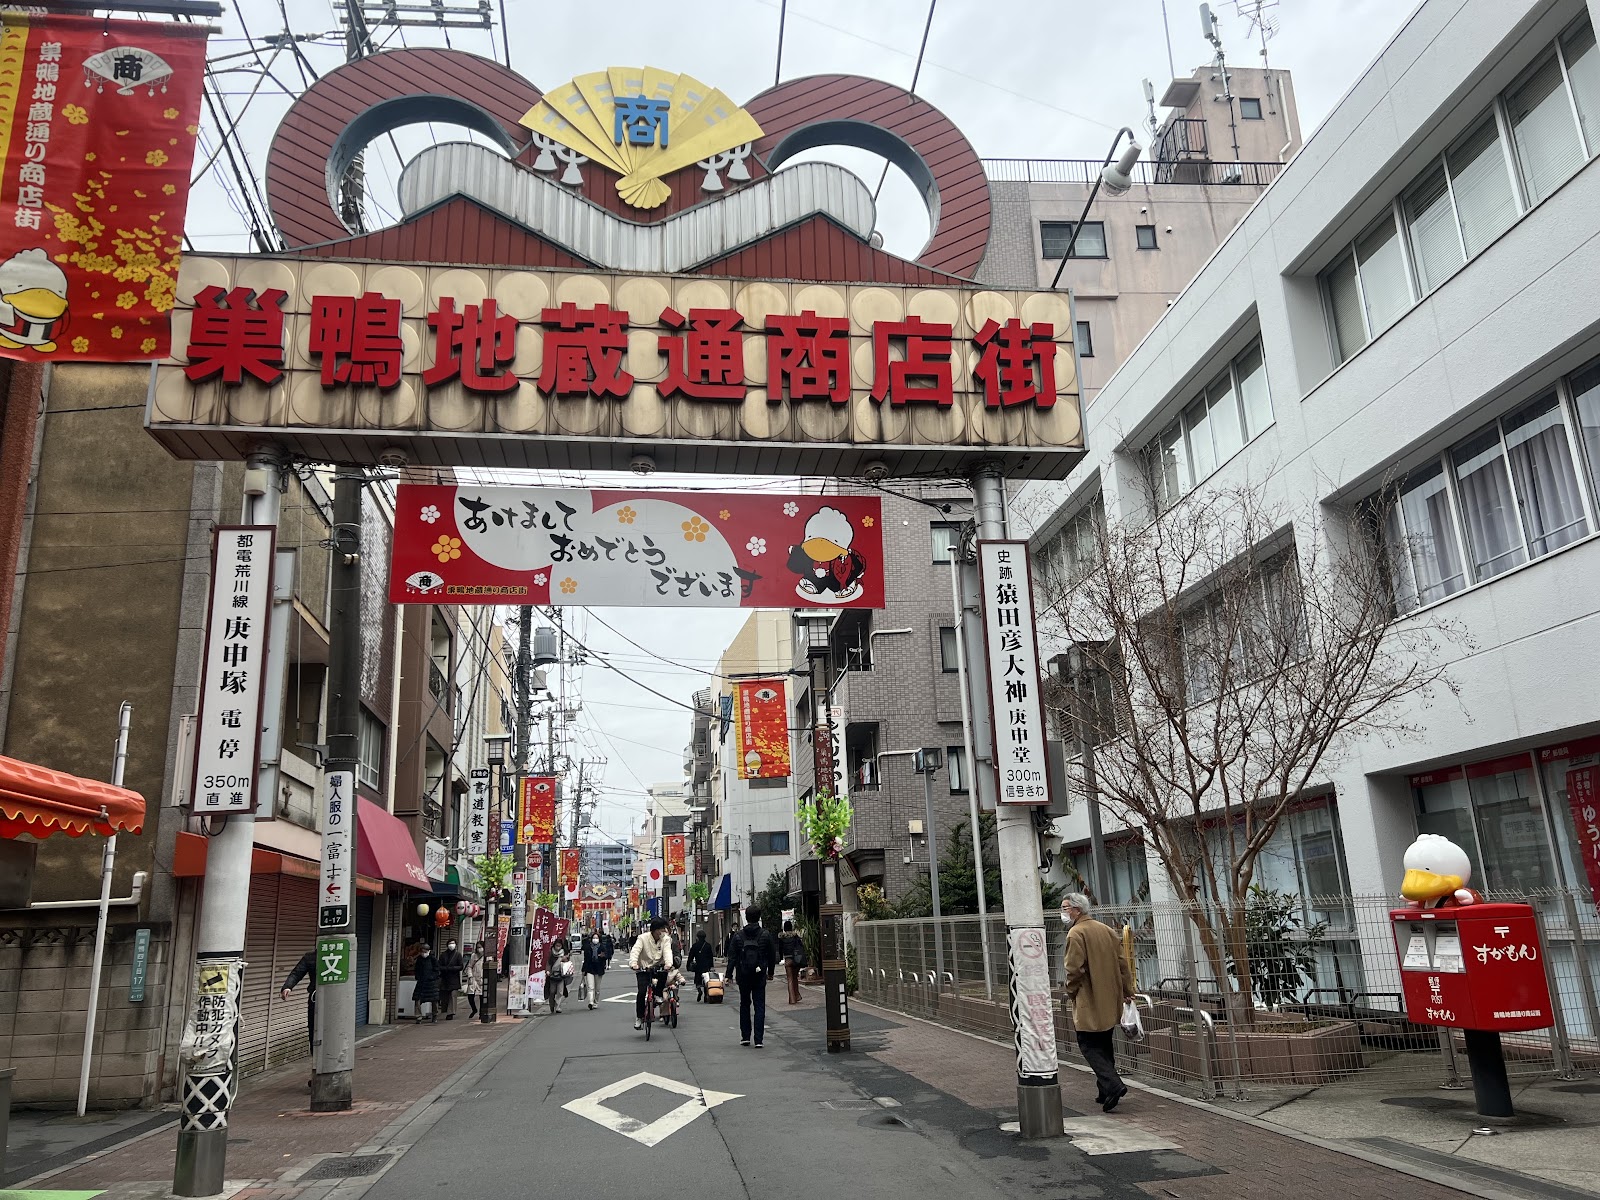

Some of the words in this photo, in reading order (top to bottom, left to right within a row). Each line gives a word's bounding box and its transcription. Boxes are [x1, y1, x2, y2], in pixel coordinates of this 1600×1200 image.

[113, 55, 144, 81] 商
[14, 41, 62, 231] 巣鴨地蔵通り商店街
[614, 95, 670, 148] 商
[183, 285, 1057, 410] 巣鴨地蔵通商店街
[458, 496, 577, 533] あけまして
[550, 533, 666, 566] おめでとう
[997, 550, 1013, 580] 史跡
[232, 534, 253, 608] 都電荒川線
[418, 575, 432, 588] 商
[650, 566, 763, 598] ございます
[447, 585, 528, 595] 巣鴨地蔵通り商店街
[219, 616, 251, 695] 庚申塚
[996, 583, 1027, 703] 猿田彦大神
[218, 709, 242, 759] 電停
[1009, 708, 1031, 764] 庚申堂
[204, 775, 249, 789] 350m
[1007, 769, 1041, 782] 300m
[206, 792, 243, 806] 直進
[1005, 785, 1045, 798] 信号きわ
[471, 780, 486, 844] 書道教室
[320, 953, 342, 976] 文
[1473, 943, 1537, 965] すがもん
[133, 977, 143, 985] 17
[1426, 1007, 1456, 1021] すがもん
[1431, 995, 1443, 1005] POST
[207, 996, 225, 1058] 防犯カメラ
